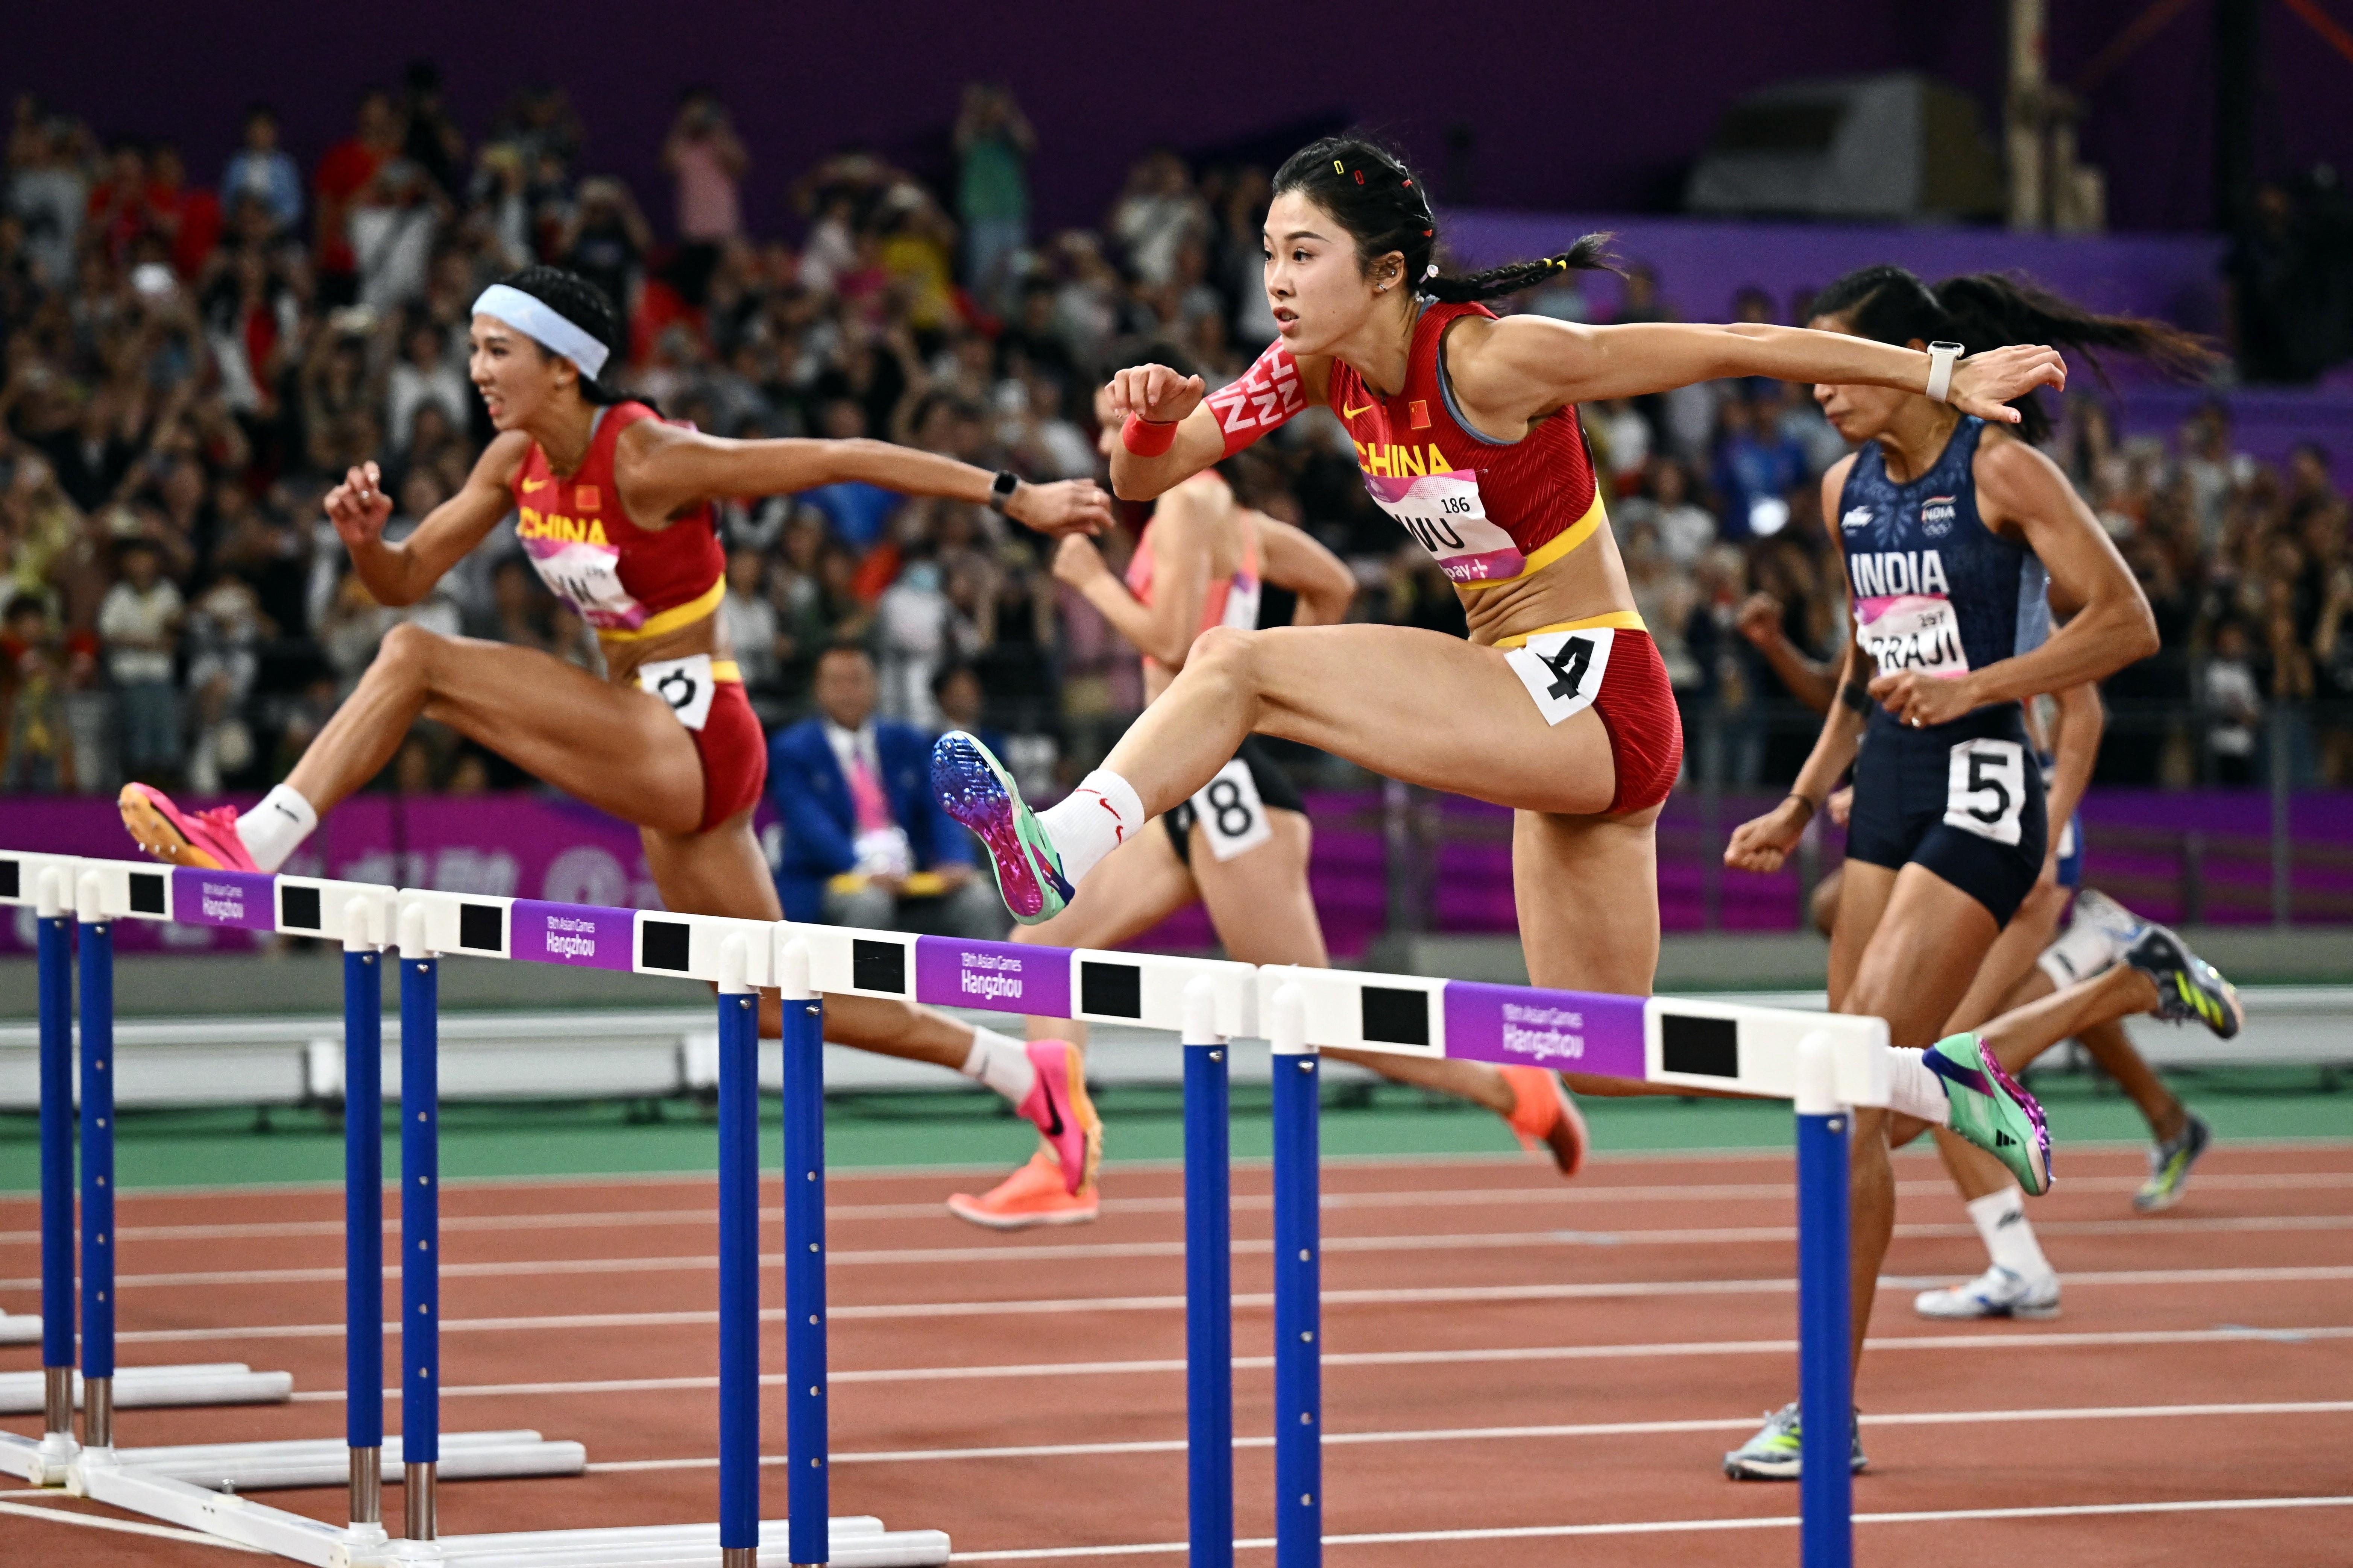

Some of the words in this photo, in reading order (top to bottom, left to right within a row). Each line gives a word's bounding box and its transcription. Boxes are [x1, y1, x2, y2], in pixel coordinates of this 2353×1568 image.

[1353, 439, 1454, 478] CHINA
[1441, 497, 1470, 513] 186
[1922, 505, 1956, 523] INDIA
[519, 506, 608, 546] CHINA
[1851, 550, 1950, 597] INDIA
[1536, 636, 1595, 700] 4
[1208, 779, 1253, 836] 8
[1968, 753, 2010, 823] 5
[547, 931, 595, 958] Hangzhou
[961, 969, 1022, 1000] Hangzhou
